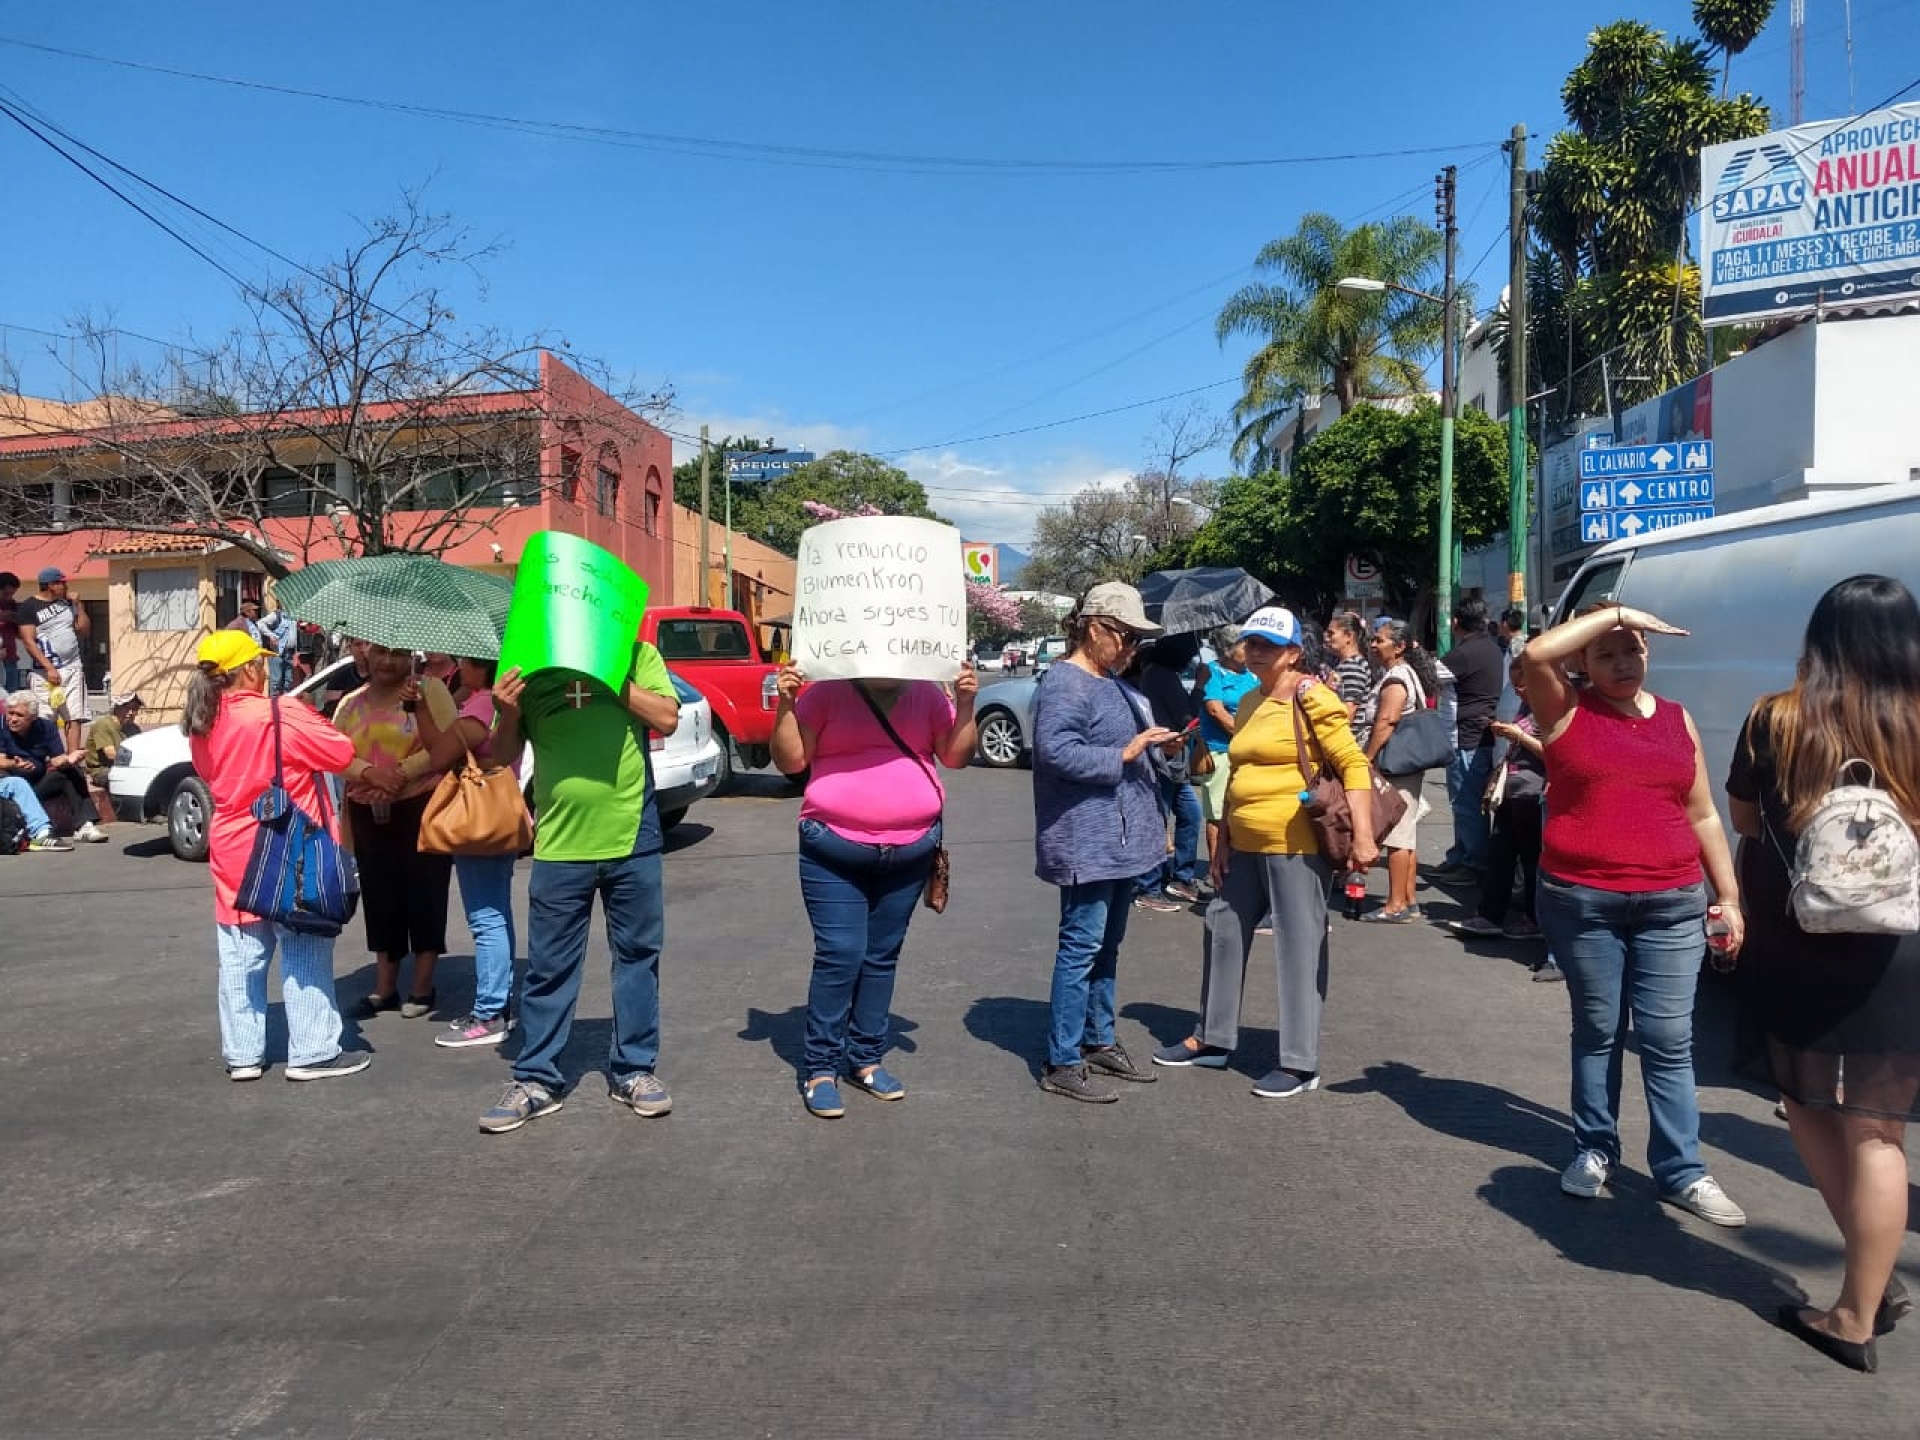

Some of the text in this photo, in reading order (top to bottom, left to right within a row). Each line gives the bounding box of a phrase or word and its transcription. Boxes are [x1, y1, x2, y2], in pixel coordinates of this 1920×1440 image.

[1814, 144, 1920, 196] ANUAL
[1716, 181, 1803, 217] SAPAC
[1717, 223, 1917, 268] PAGA 11 MESES Y RECIBE 12
[1717, 261, 1768, 282] VIGENCIA
[1772, 258, 1794, 274] DEL
[1797, 256, 1804, 271] 3
[1806, 253, 1822, 270] AL
[1825, 250, 1840, 266] 31
[1845, 247, 1860, 264] DE
[1585, 455, 1596, 471] EL
[1600, 451, 1646, 471] CALVARIO
[1648, 479, 1709, 499] CENTRO
[799, 605, 847, 627] Ahora
[864, 605, 929, 626] sigues
[809, 639, 868, 660] VEGA
